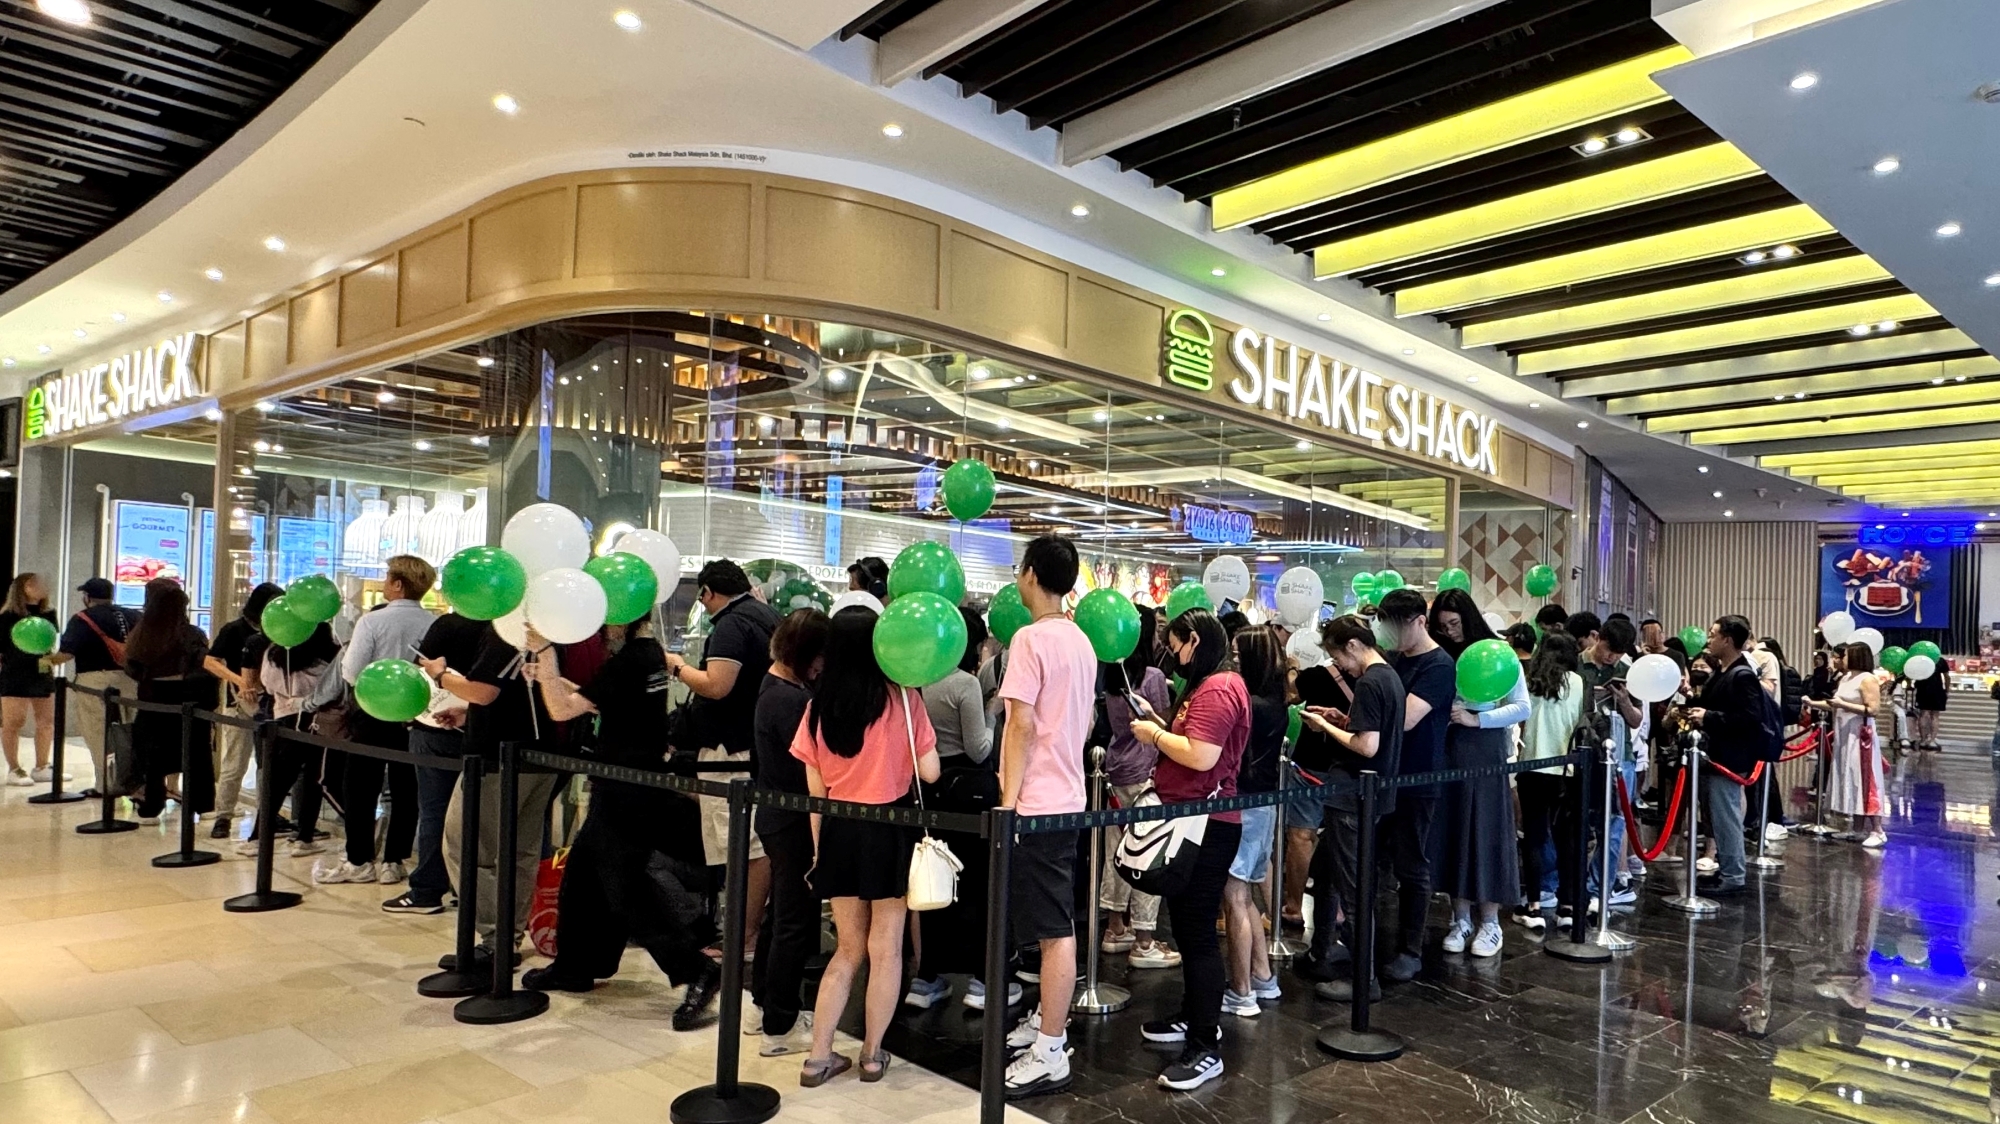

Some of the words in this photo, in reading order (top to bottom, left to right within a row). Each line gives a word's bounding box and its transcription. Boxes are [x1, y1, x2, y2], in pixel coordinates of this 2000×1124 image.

[44, 362, 109, 435] SHAKE
[106, 331, 195, 419] SHACK
[1230, 327, 1384, 441] SHAKE
[1387, 383, 1498, 476] SHACK
[132, 522, 175, 532] GOURMET
